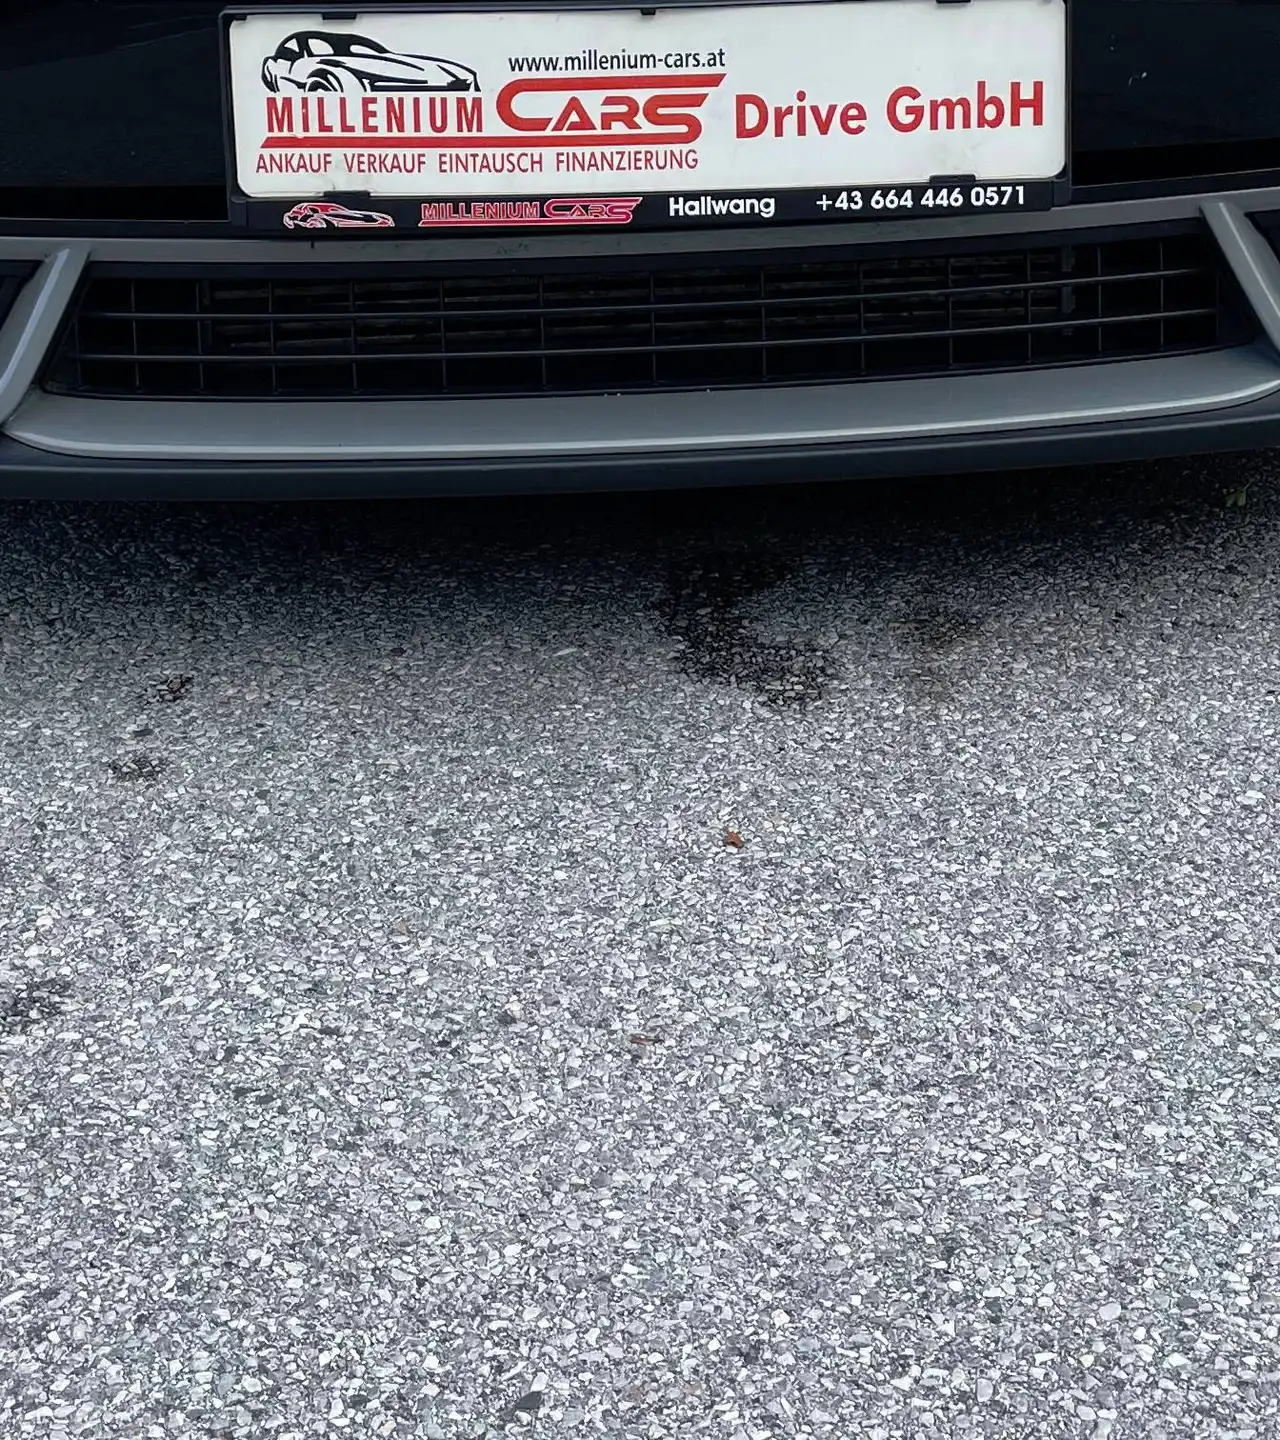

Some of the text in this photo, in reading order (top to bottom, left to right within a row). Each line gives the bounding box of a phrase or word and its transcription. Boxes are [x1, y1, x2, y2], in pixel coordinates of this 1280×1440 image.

[508, 48, 726, 72] www.millenium-cars.at
[266, 73, 1043, 147] MILLENIUM CARS Drive GmbH
[256, 149, 699, 174] ANKAUF VERKAUF EINTAUSCH FINANZIERUNG
[421, 186, 1025, 224] MILLENIUM CARS Hallwang +43 664 446 0571
